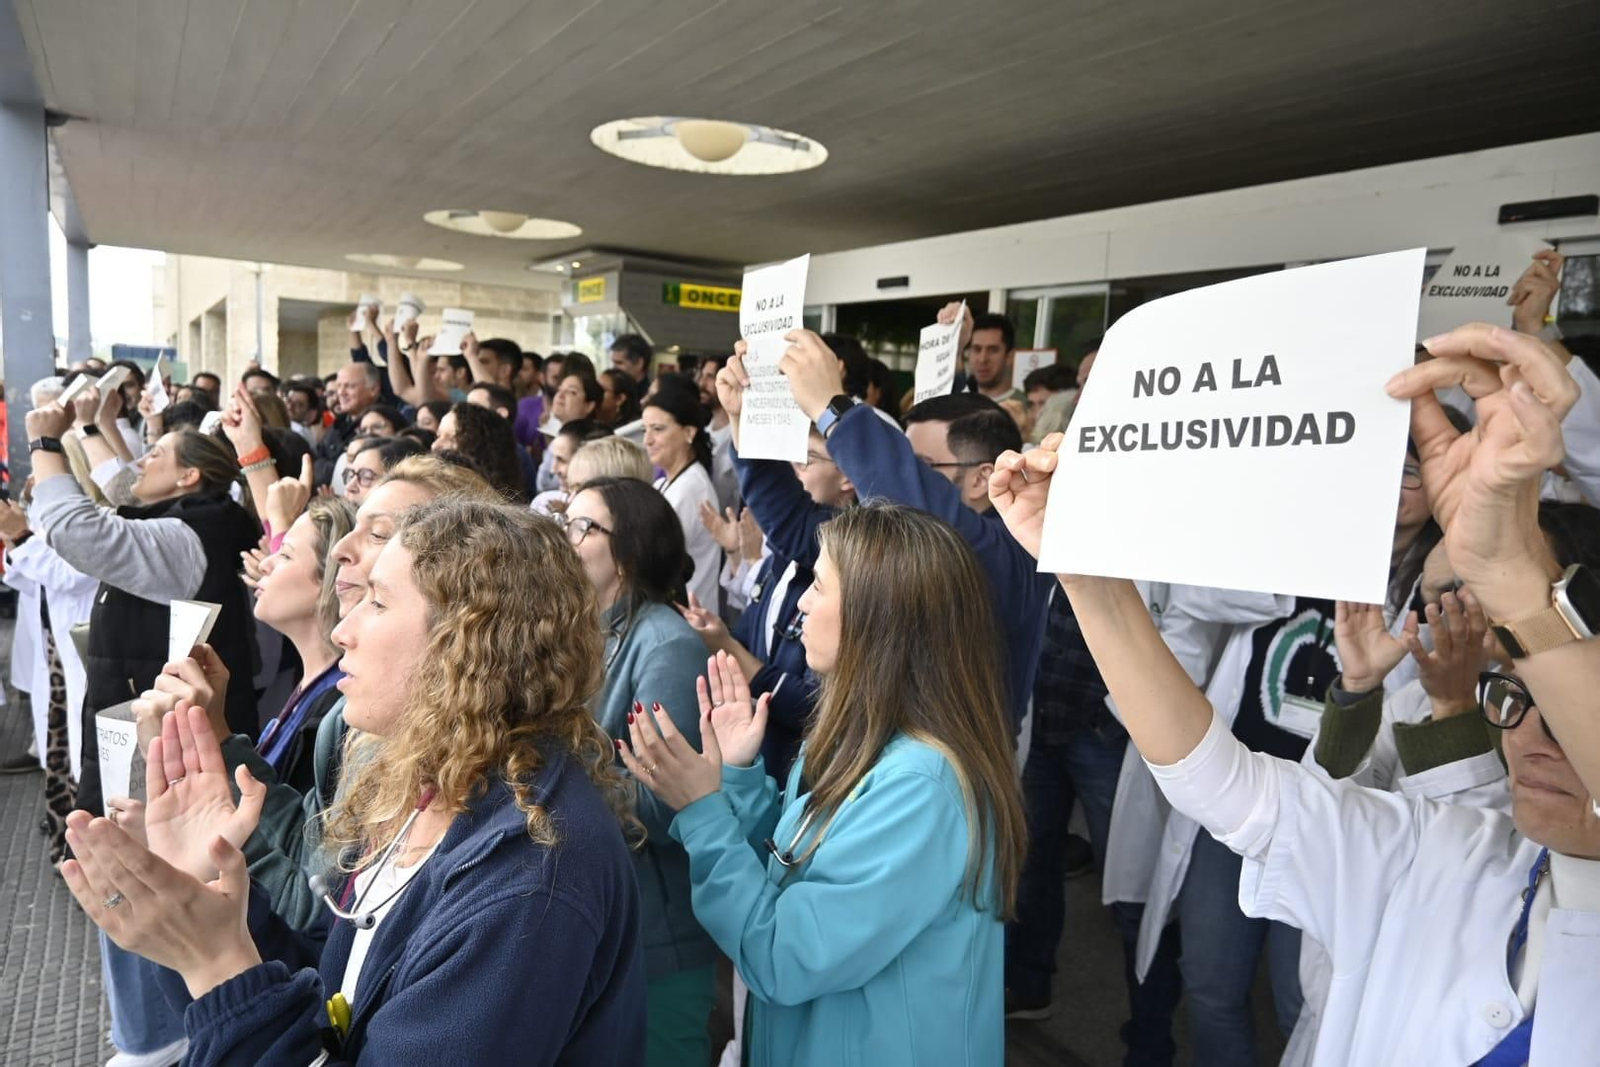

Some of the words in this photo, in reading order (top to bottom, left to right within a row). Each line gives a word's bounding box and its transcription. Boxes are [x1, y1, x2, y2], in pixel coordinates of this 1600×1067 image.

[1453, 265, 1470, 277] NO
[1473, 265, 1481, 277] A
[1484, 265, 1500, 277] LA
[688, 290, 739, 307] ONCE
[1428, 285, 1509, 298] EXCLUSIVIDAD
[756, 298, 767, 311] NO
[769, 298, 775, 309] A
[775, 294, 784, 308] LA
[744, 316, 793, 337] EXCLUSIVIDAD
[1133, 366, 1181, 398] NO
[1192, 362, 1217, 393] A
[1231, 354, 1282, 389] LA
[1078, 411, 1356, 453] EXCLUSIVIDAD
